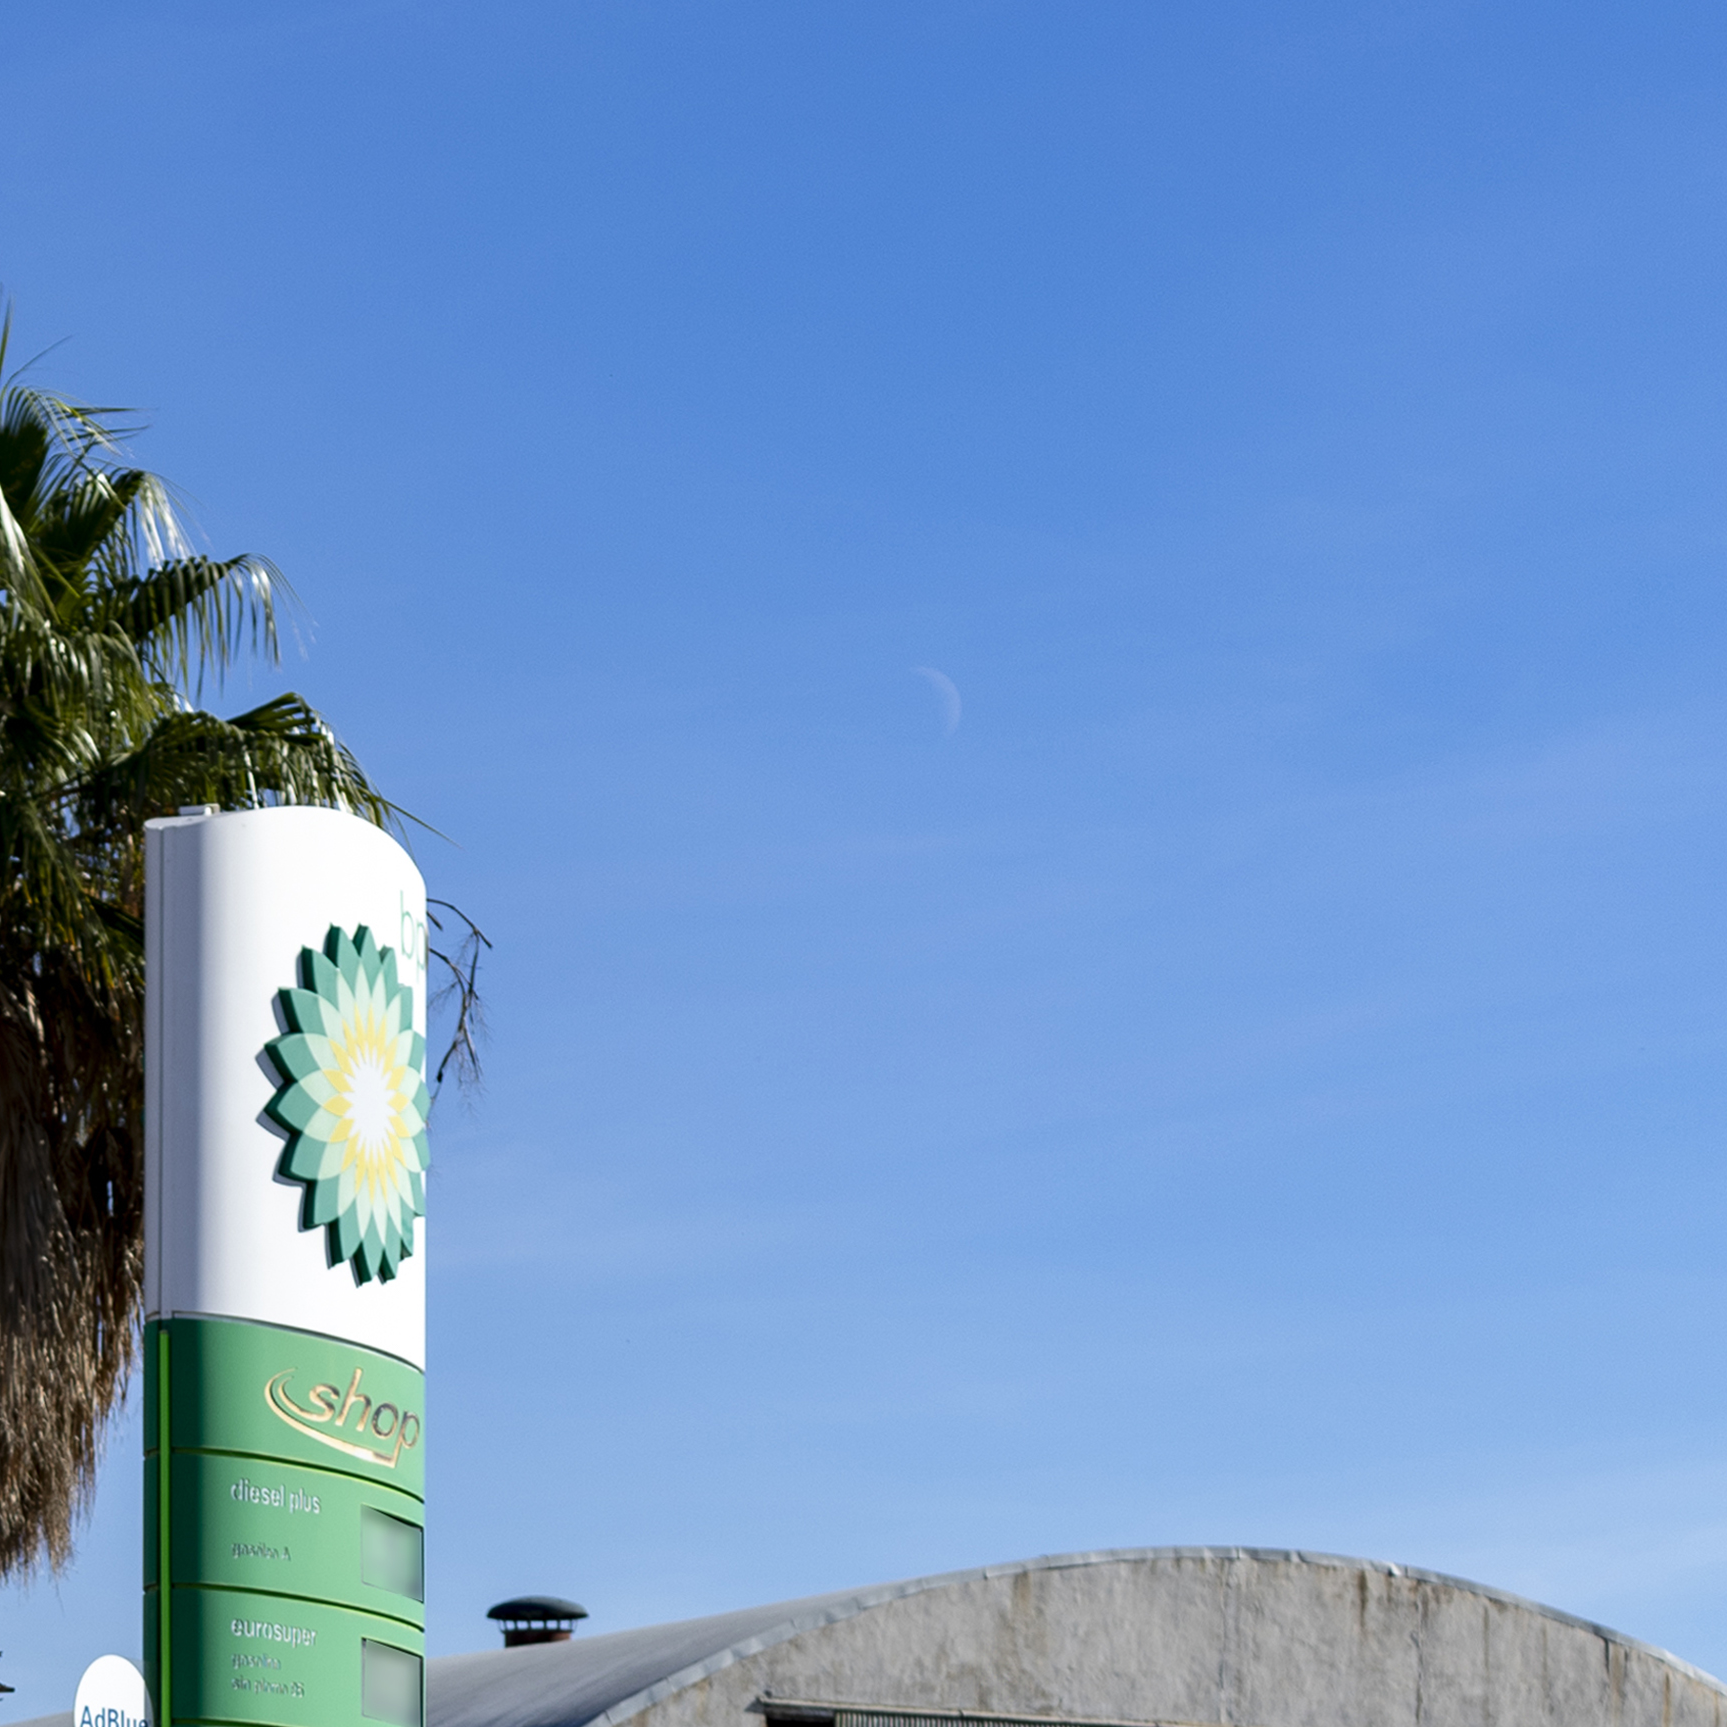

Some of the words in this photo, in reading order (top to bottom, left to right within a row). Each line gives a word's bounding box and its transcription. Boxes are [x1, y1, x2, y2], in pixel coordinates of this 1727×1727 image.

[289, 1366, 420, 1468] shop
[231, 1479, 285, 1507] diesel
[289, 1487, 320, 1513] plus
[231, 1618, 317, 1647] eurosuper
[231, 1675, 250, 1690] sin
